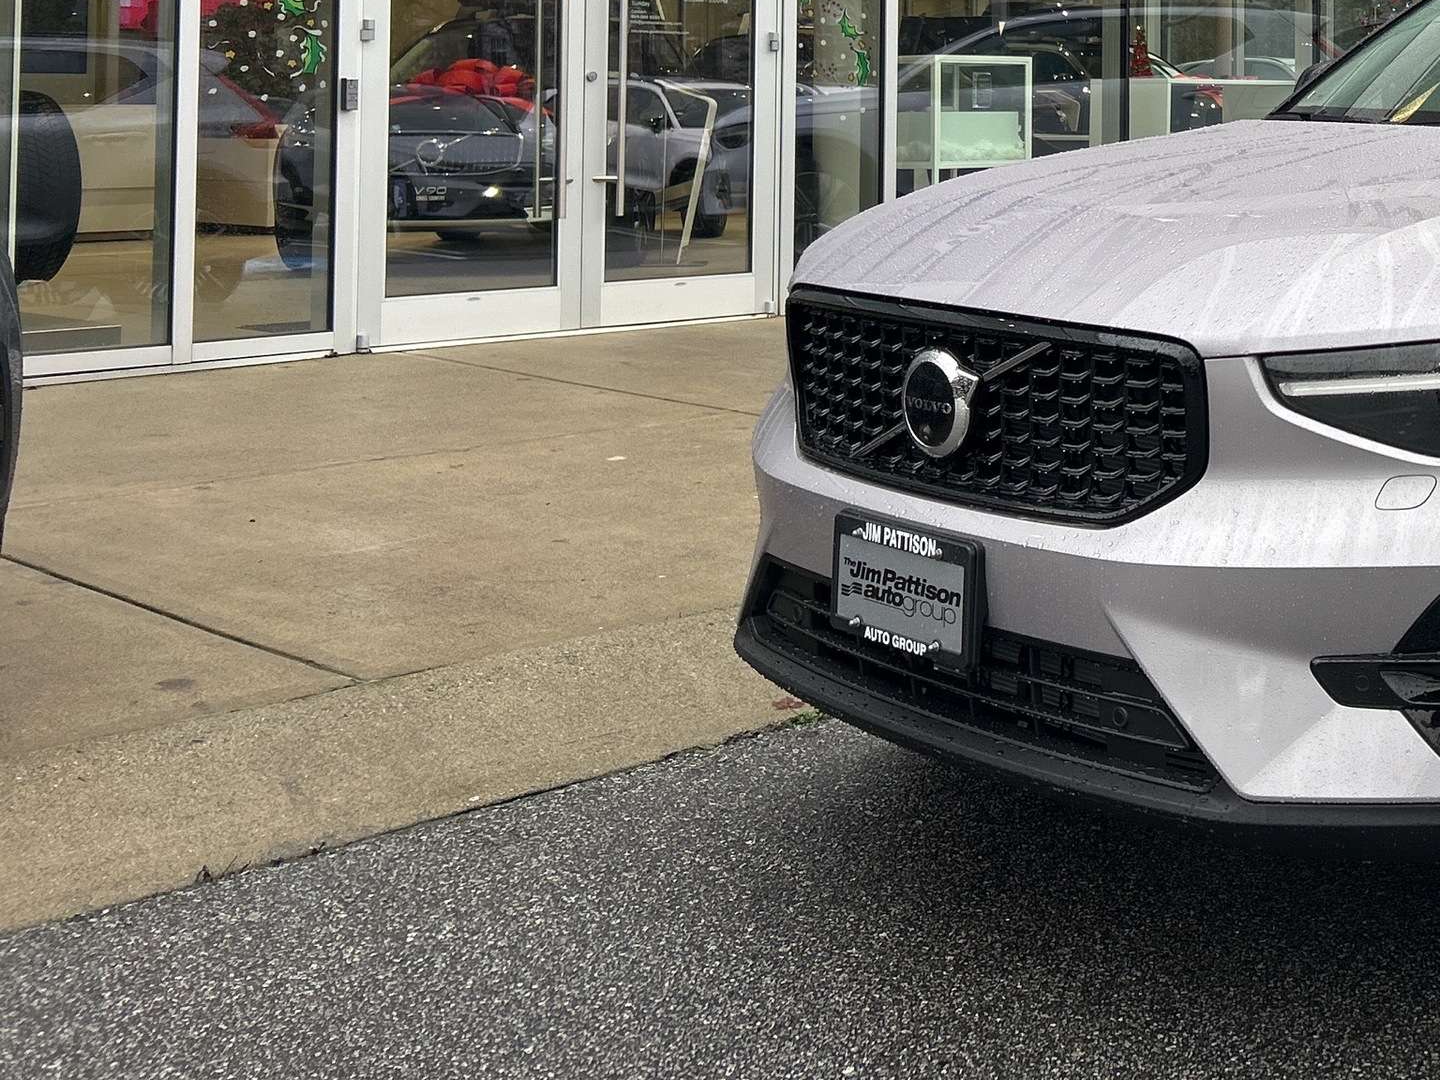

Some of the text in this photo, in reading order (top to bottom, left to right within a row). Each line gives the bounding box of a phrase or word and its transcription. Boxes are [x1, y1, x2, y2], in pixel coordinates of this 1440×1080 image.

[906, 395, 952, 415] VOLVO
[862, 522, 937, 557] JIM PATTISON
[843, 556, 857, 568] The
[864, 626, 927, 657] AUTO GROUP
